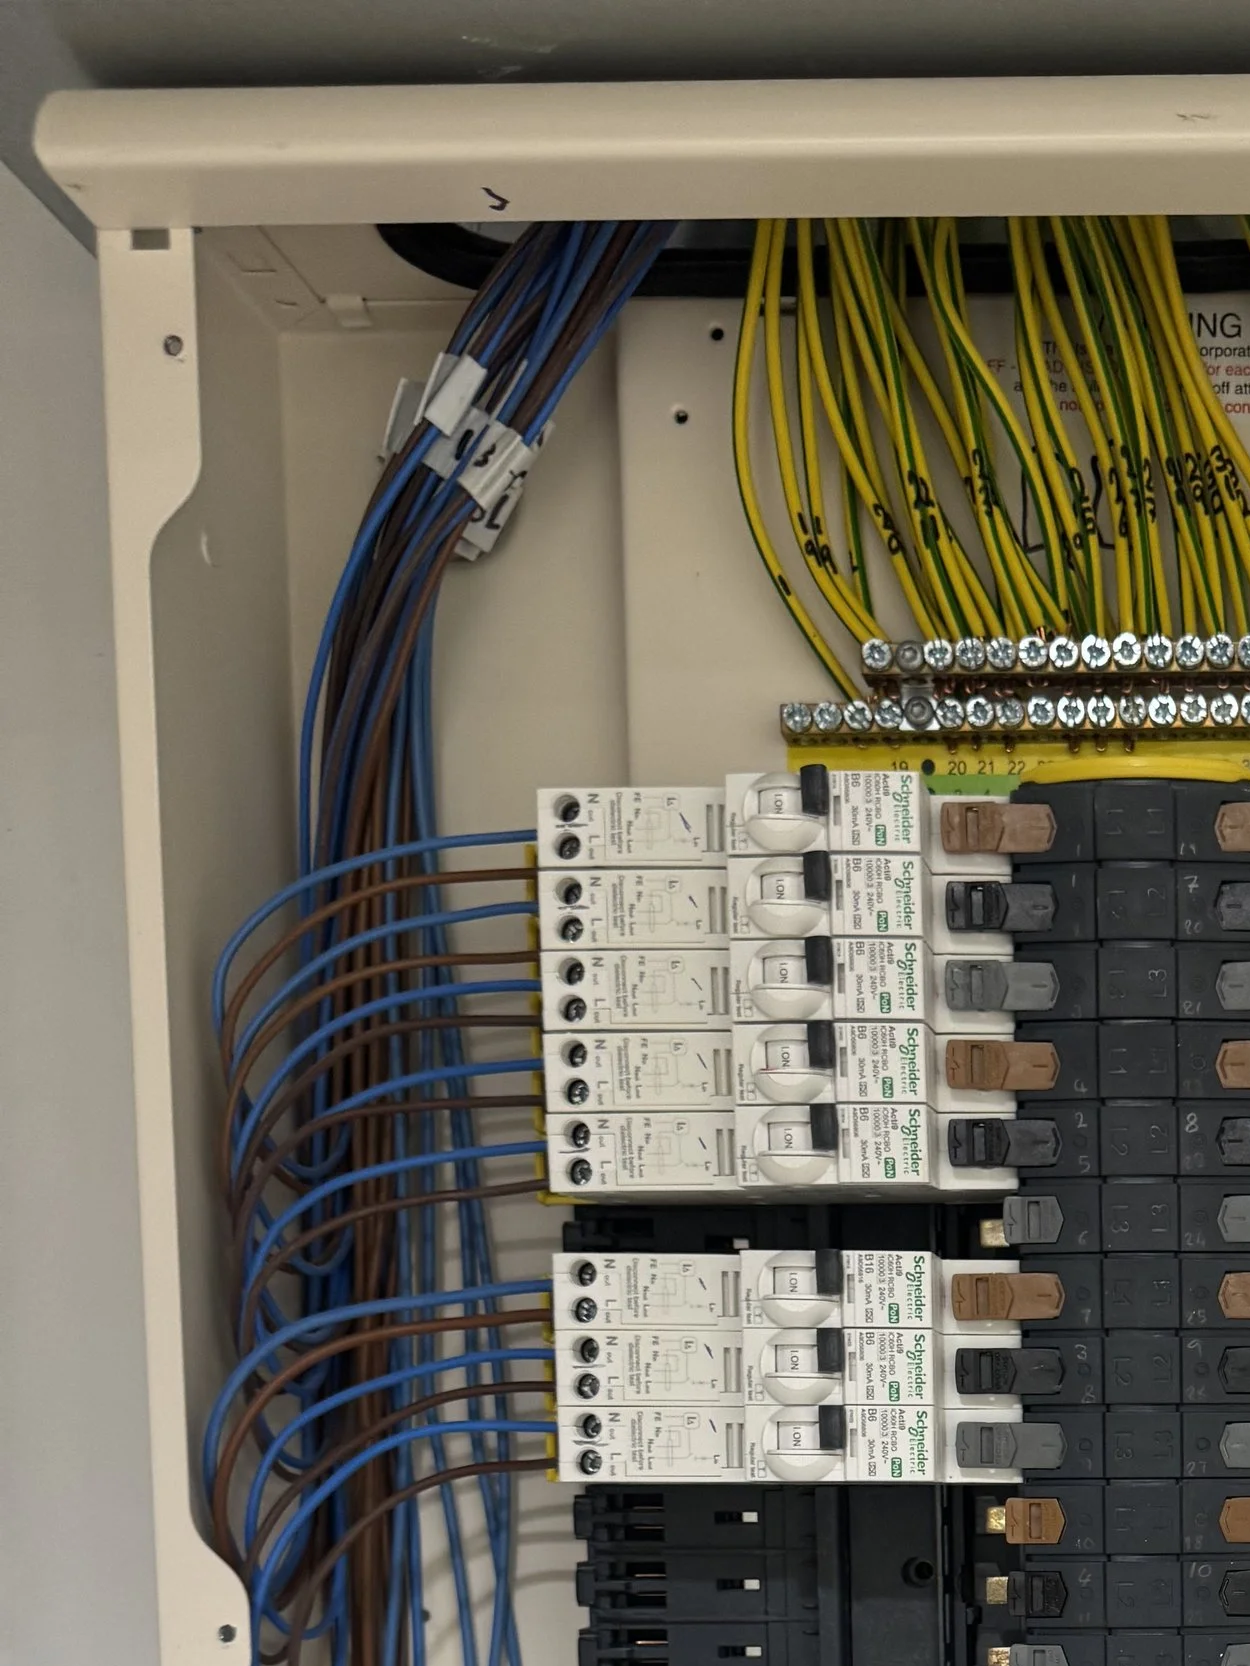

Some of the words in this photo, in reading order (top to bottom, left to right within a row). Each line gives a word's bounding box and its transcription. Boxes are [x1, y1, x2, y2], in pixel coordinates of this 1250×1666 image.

[948, 761, 966, 775] 20
[978, 761, 994, 775] 21
[1008, 761, 1025, 775] 22
[852, 773, 859, 787] B6
[900, 775, 912, 844] Schneider
[853, 857, 860, 871] B6
[902, 861, 913, 930] Schneider
[855, 941, 864, 956] B6
[904, 942, 915, 1011] Schneider
[881, 993, 889, 1012] PoN
[857, 1025, 866, 1039] B6
[906, 1028, 917, 1096] Schneider
[883, 1078, 891, 1096] PoN
[859, 1107, 868, 1121] B6
[909, 1109, 919, 1176] Schneider
[886, 1159, 894, 1177] PoN
[914, 1256, 924, 1322] Schneider
[890, 1305, 898, 1322] PoN
[866, 1332, 874, 1345] B6
[914, 1334, 925, 1400] Schneider
[891, 1382, 899, 1400] PoN
[868, 1409, 876, 1422] B6
[916, 1410, 925, 1475] Schneider
[892, 1459, 900, 1476] PoN
